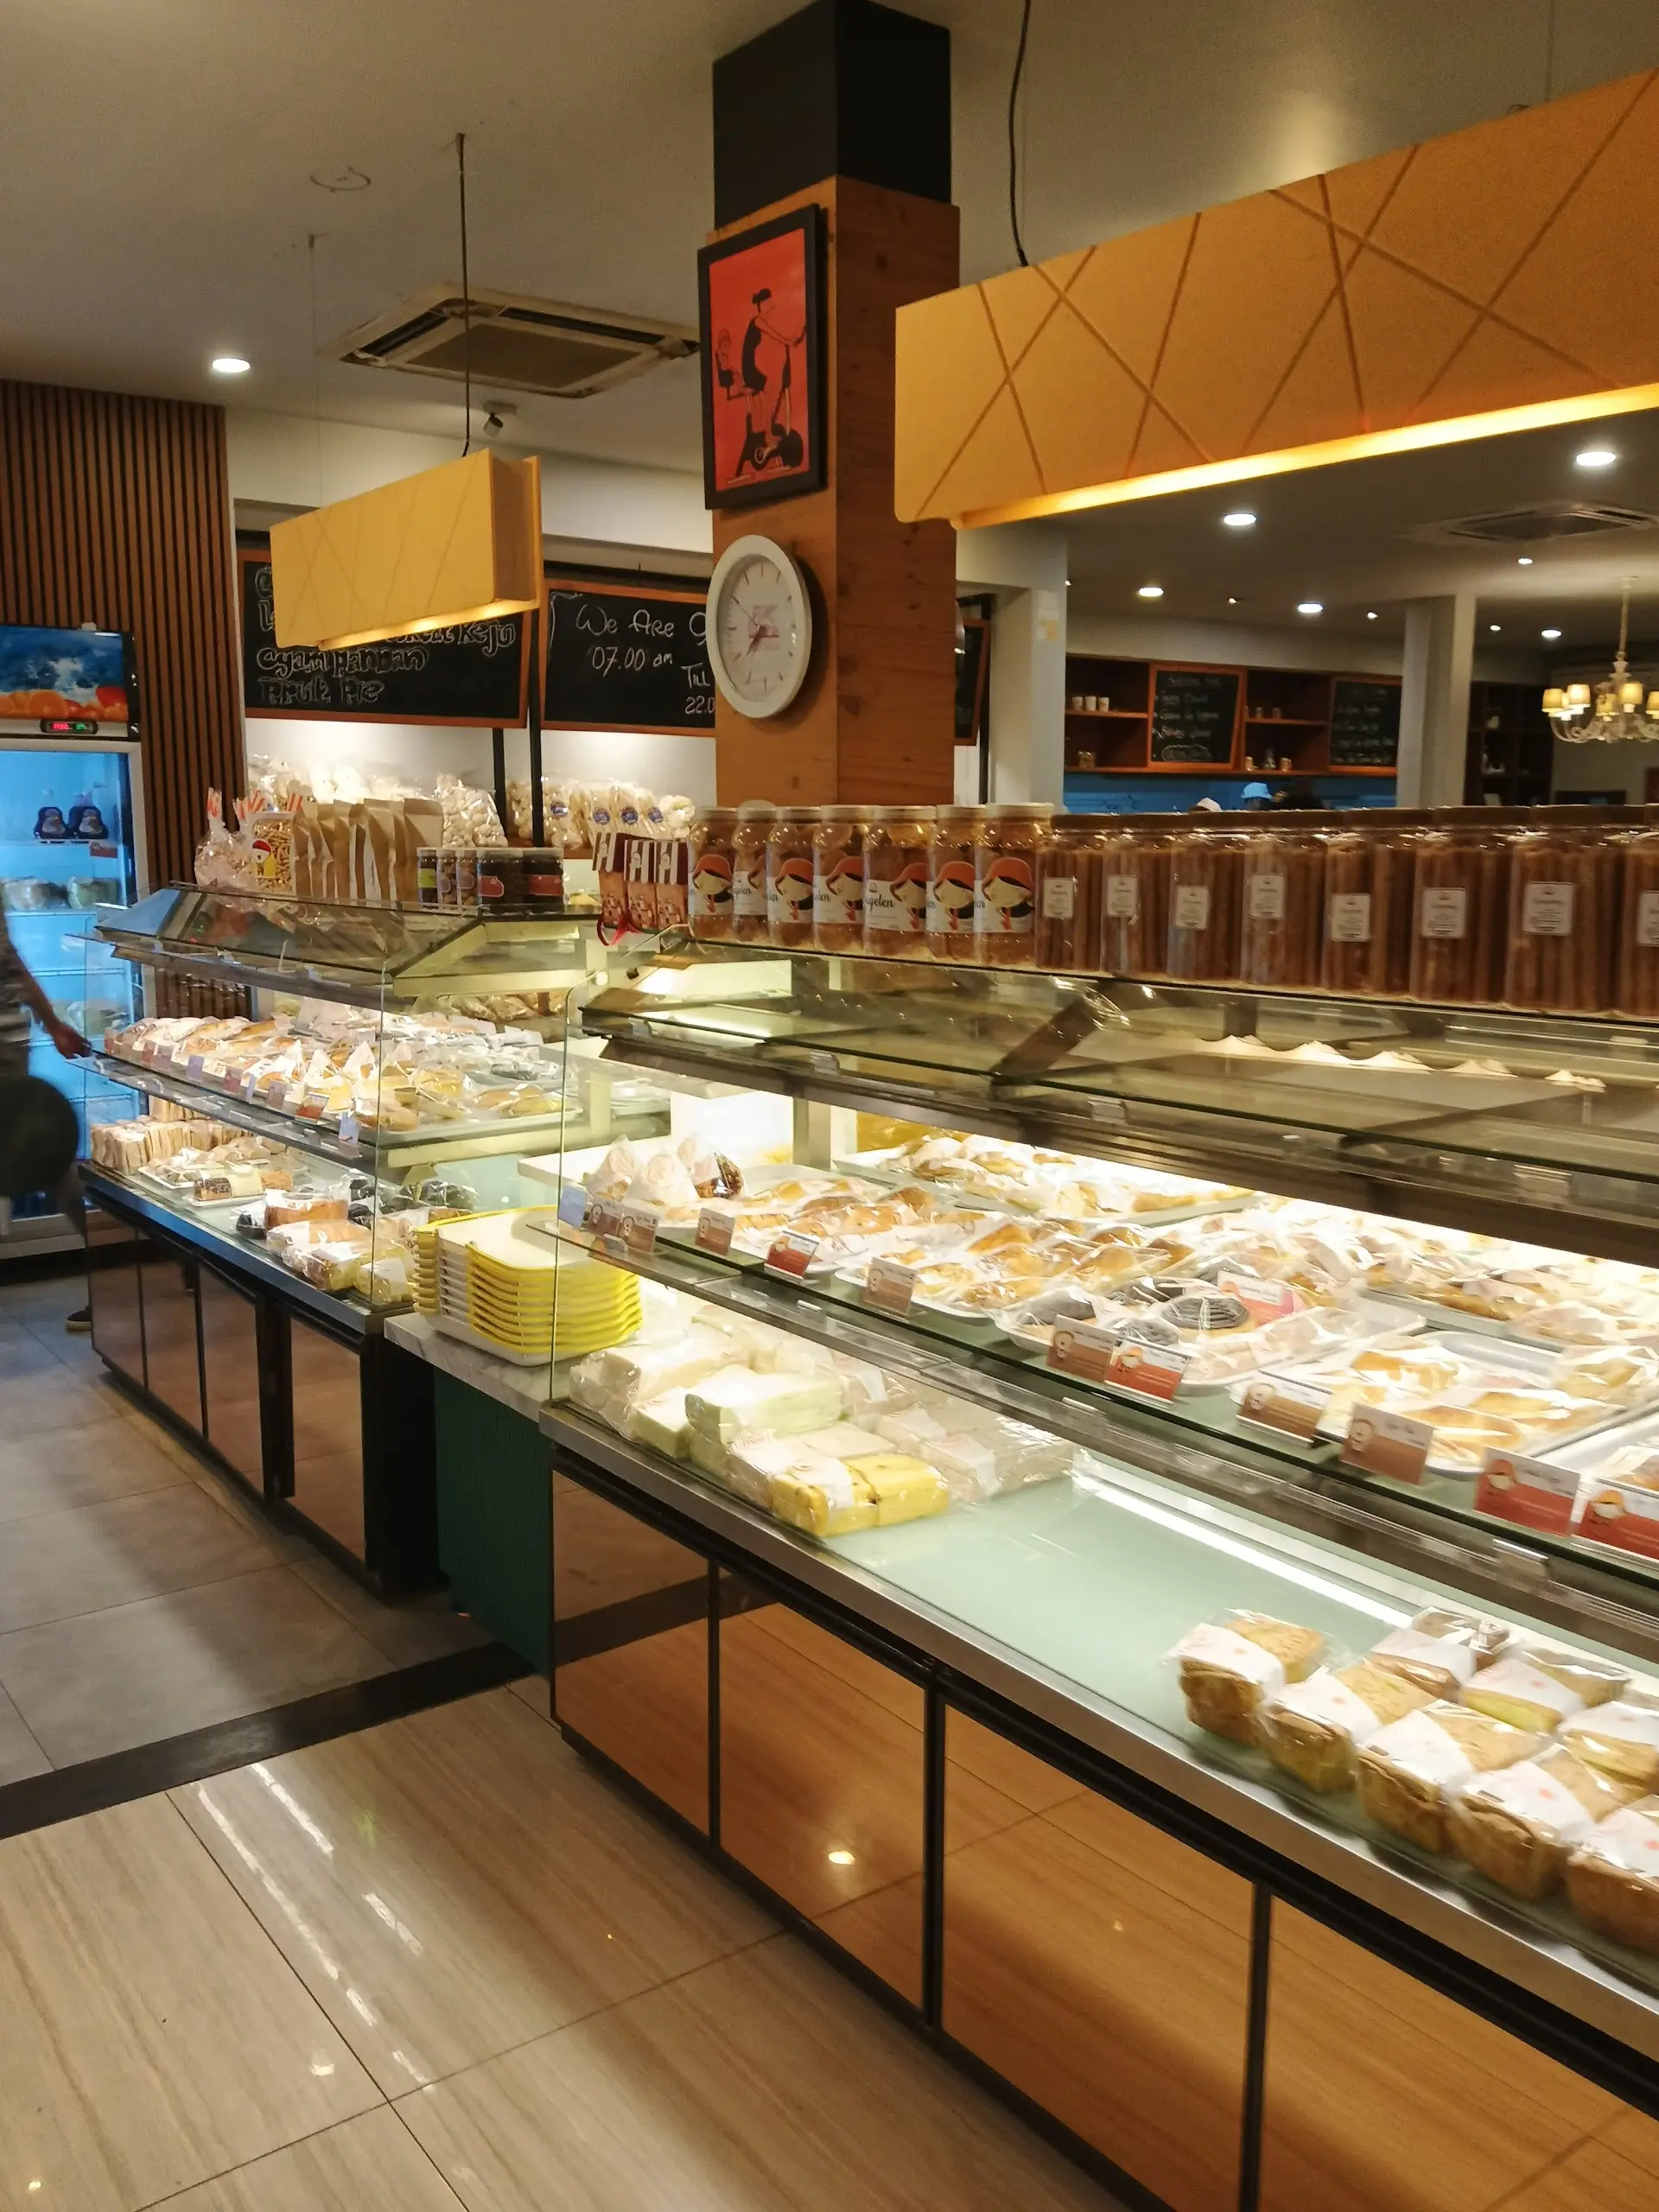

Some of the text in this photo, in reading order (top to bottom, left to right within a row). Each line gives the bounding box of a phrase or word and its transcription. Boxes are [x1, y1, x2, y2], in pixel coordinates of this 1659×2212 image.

[575, 603, 619, 637] We
[592, 645, 673, 677] 07.00 am
